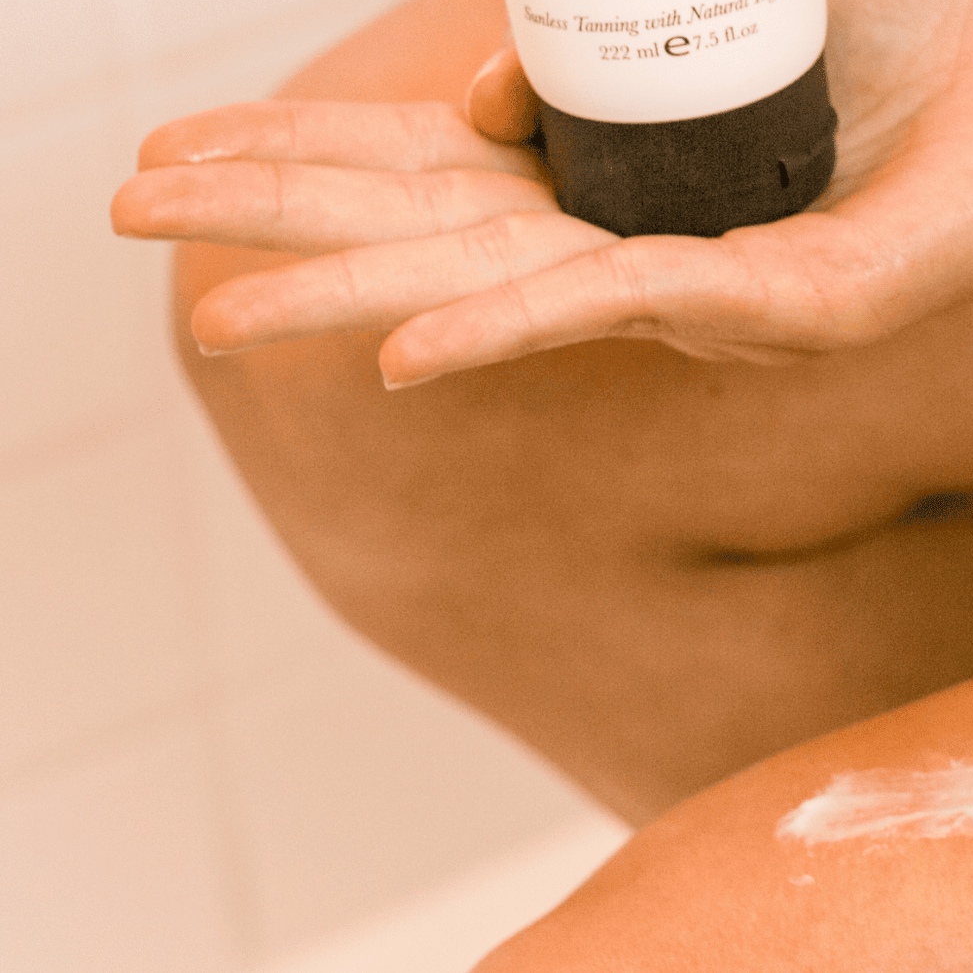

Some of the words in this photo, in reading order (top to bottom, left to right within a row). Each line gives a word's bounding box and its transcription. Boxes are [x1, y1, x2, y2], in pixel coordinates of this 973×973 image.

[524, 5, 568, 31] Sunless
[573, 15, 639, 37] Tanning
[644, 9, 681, 31] with
[599, 45, 631, 61] 222
[637, 42, 660, 59] ml
[692, 31, 719, 50] 7.5
[725, 23, 759, 42] fl.oz
